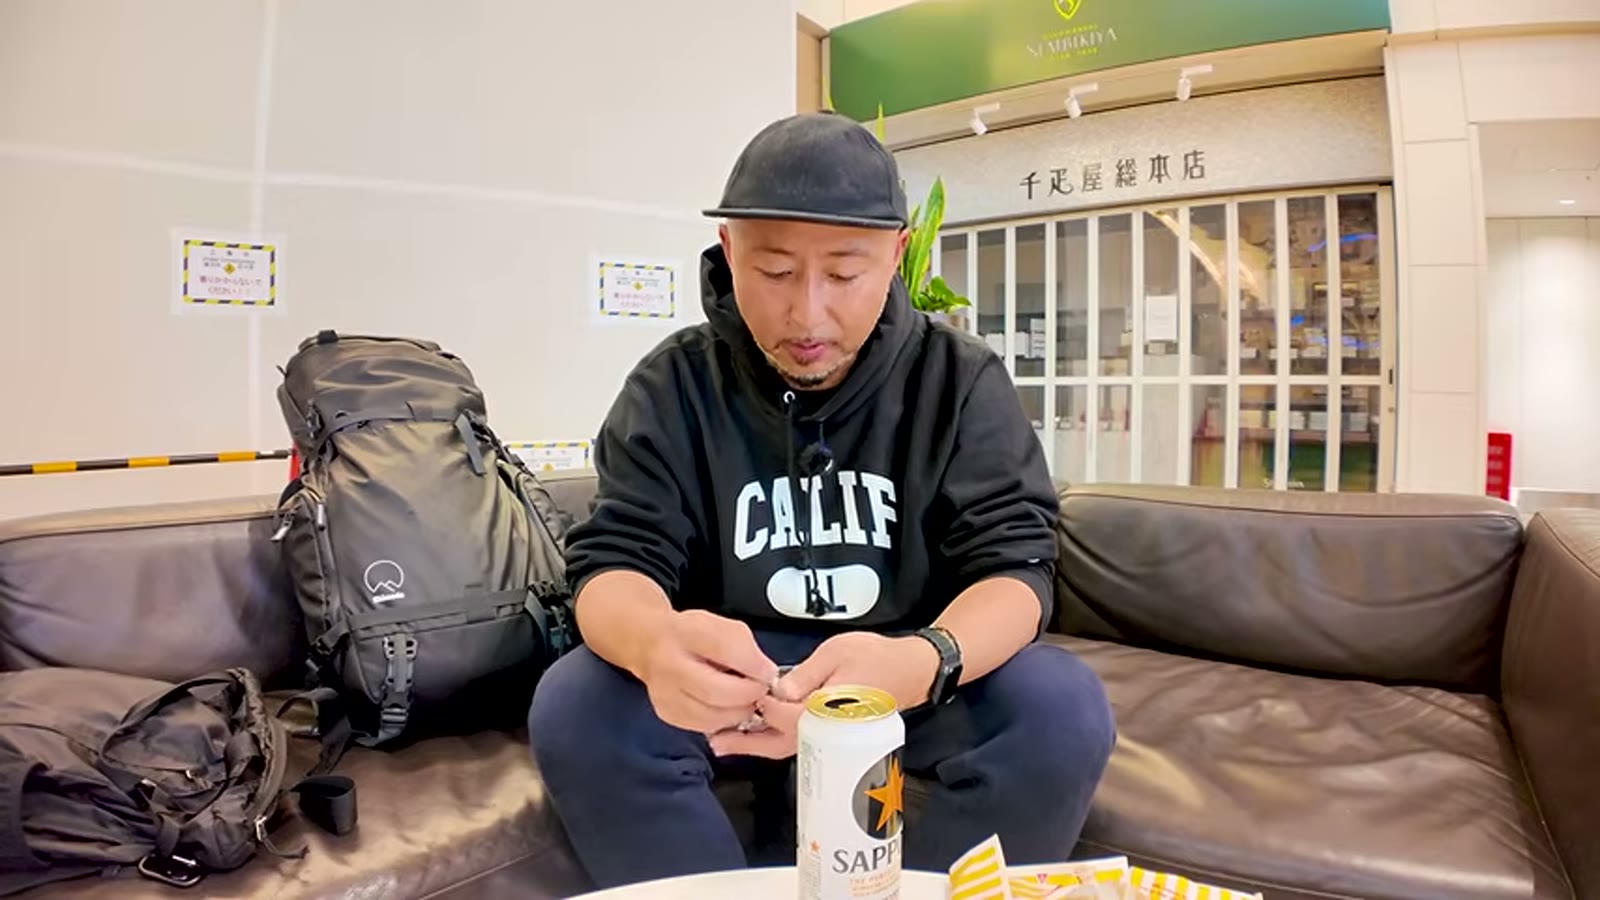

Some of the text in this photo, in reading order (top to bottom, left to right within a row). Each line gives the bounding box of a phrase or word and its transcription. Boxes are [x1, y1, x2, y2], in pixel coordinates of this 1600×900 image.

[1019, 149, 1206, 200] 千疋屋総本店
[734, 470, 898, 561] CALIF
